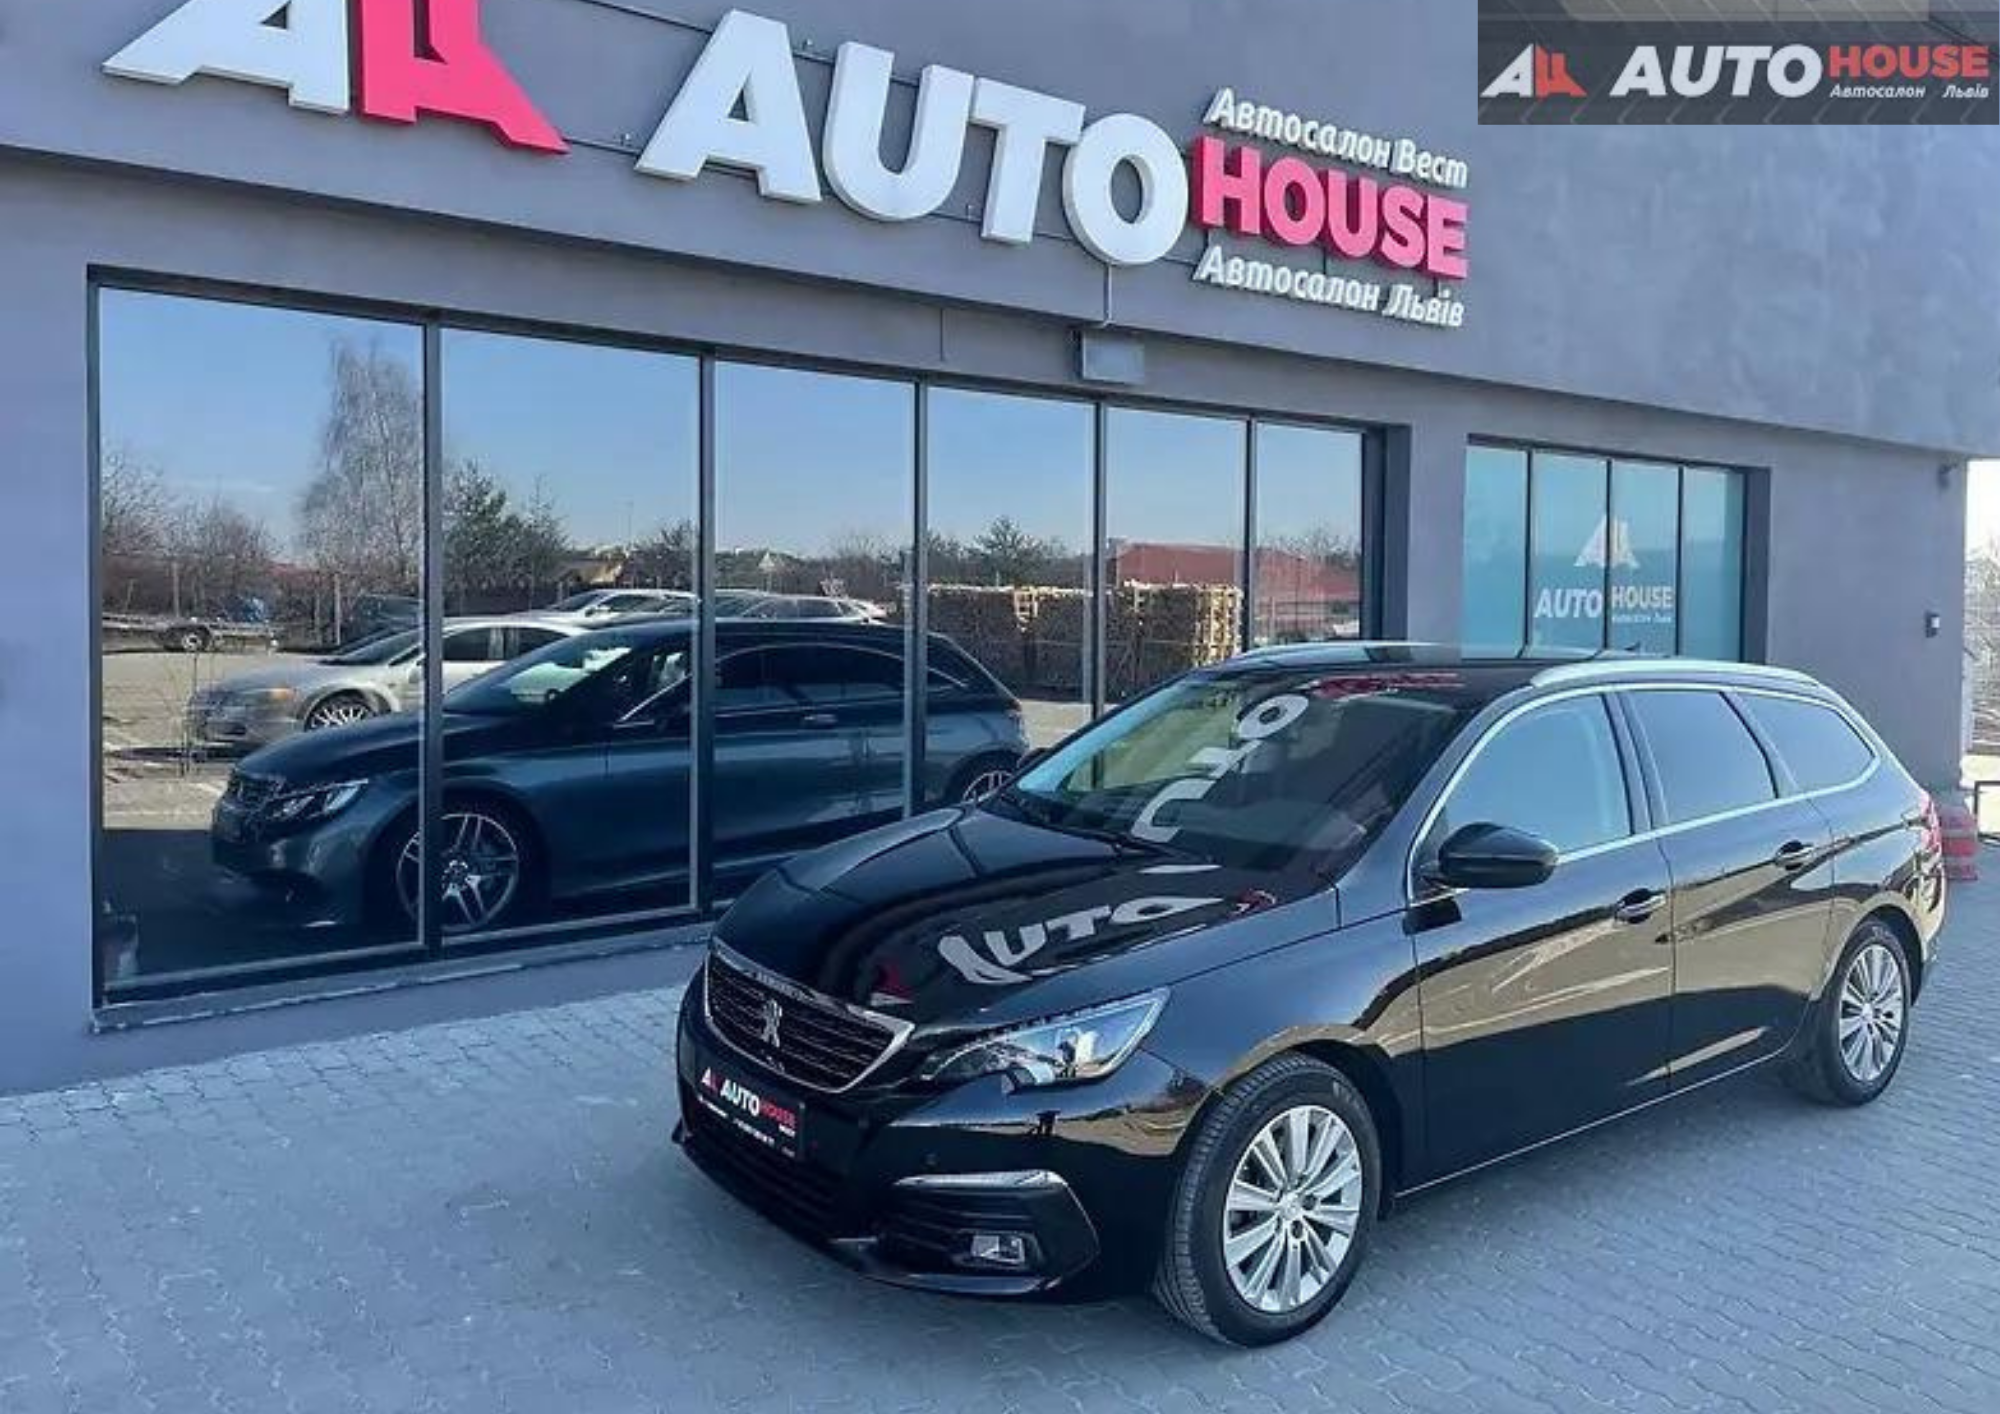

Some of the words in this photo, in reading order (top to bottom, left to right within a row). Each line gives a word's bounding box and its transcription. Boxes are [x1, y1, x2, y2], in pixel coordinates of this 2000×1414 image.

[635, 9, 1188, 266] AUTO
[1203, 87, 1391, 168] Автосалон
[1390, 138, 1469, 188] Вест
[1191, 135, 1469, 280] HOUSE
[1192, 244, 1381, 313] Автосалон
[1382, 283, 1465, 328] Львів
[1534, 587, 1604, 618] AUTO
[1611, 585, 1674, 609] HOUSE
[720, 1079, 760, 1117] AUTO
